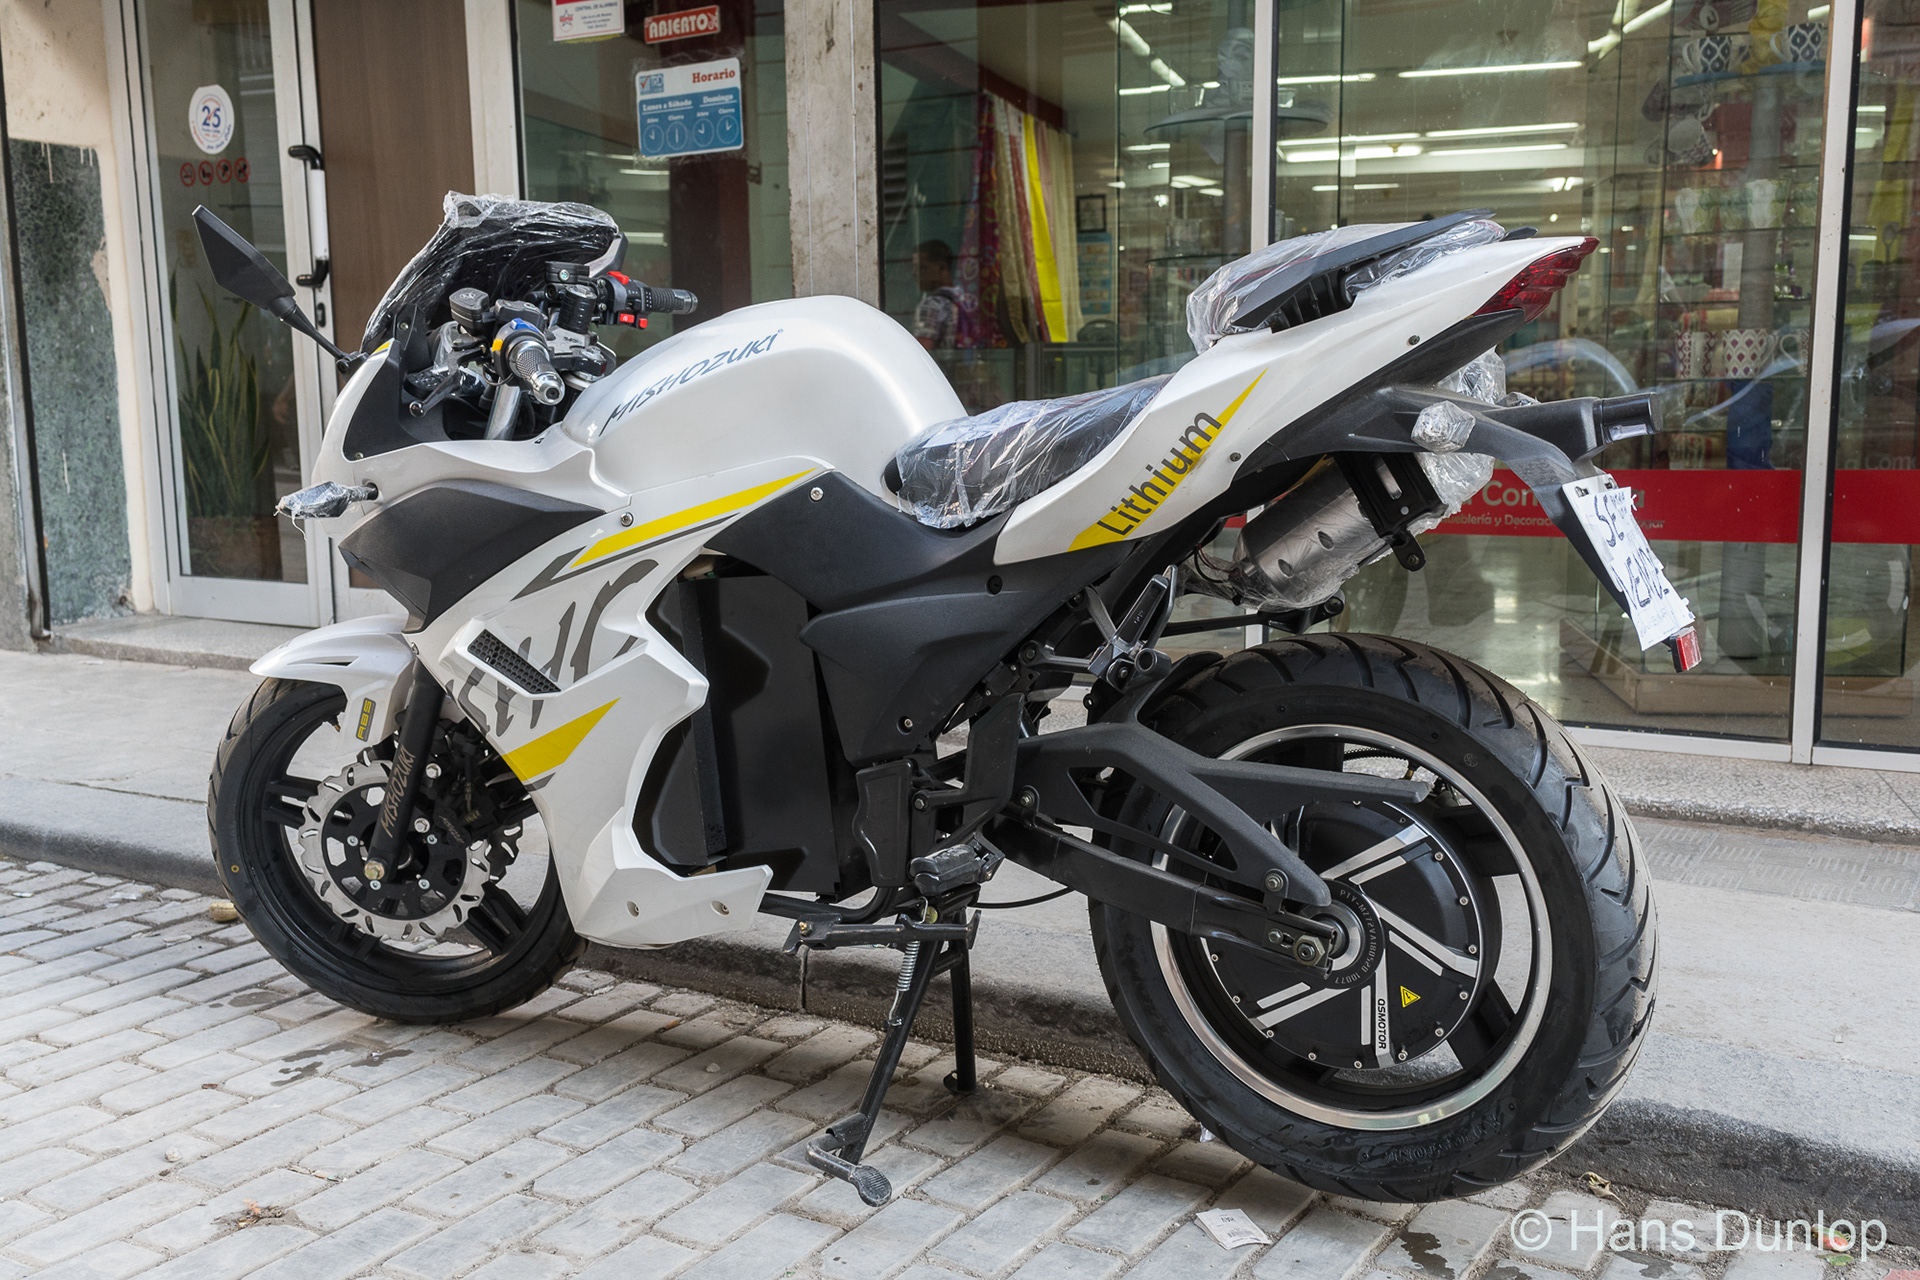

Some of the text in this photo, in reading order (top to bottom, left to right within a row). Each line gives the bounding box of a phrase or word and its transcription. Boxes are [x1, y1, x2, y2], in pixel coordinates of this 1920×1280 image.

[649, 13, 709, 39] ABIERTO
[692, 68, 736, 84] Horario
[202, 105, 221, 128] 25
[1096, 412, 1223, 536] Lithium
[1494, 517, 1502, 528] y
[357, 699, 372, 740] ABS
[379, 744, 417, 839] MISHOZUKI
[1335, 972, 1361, 984] 10077
